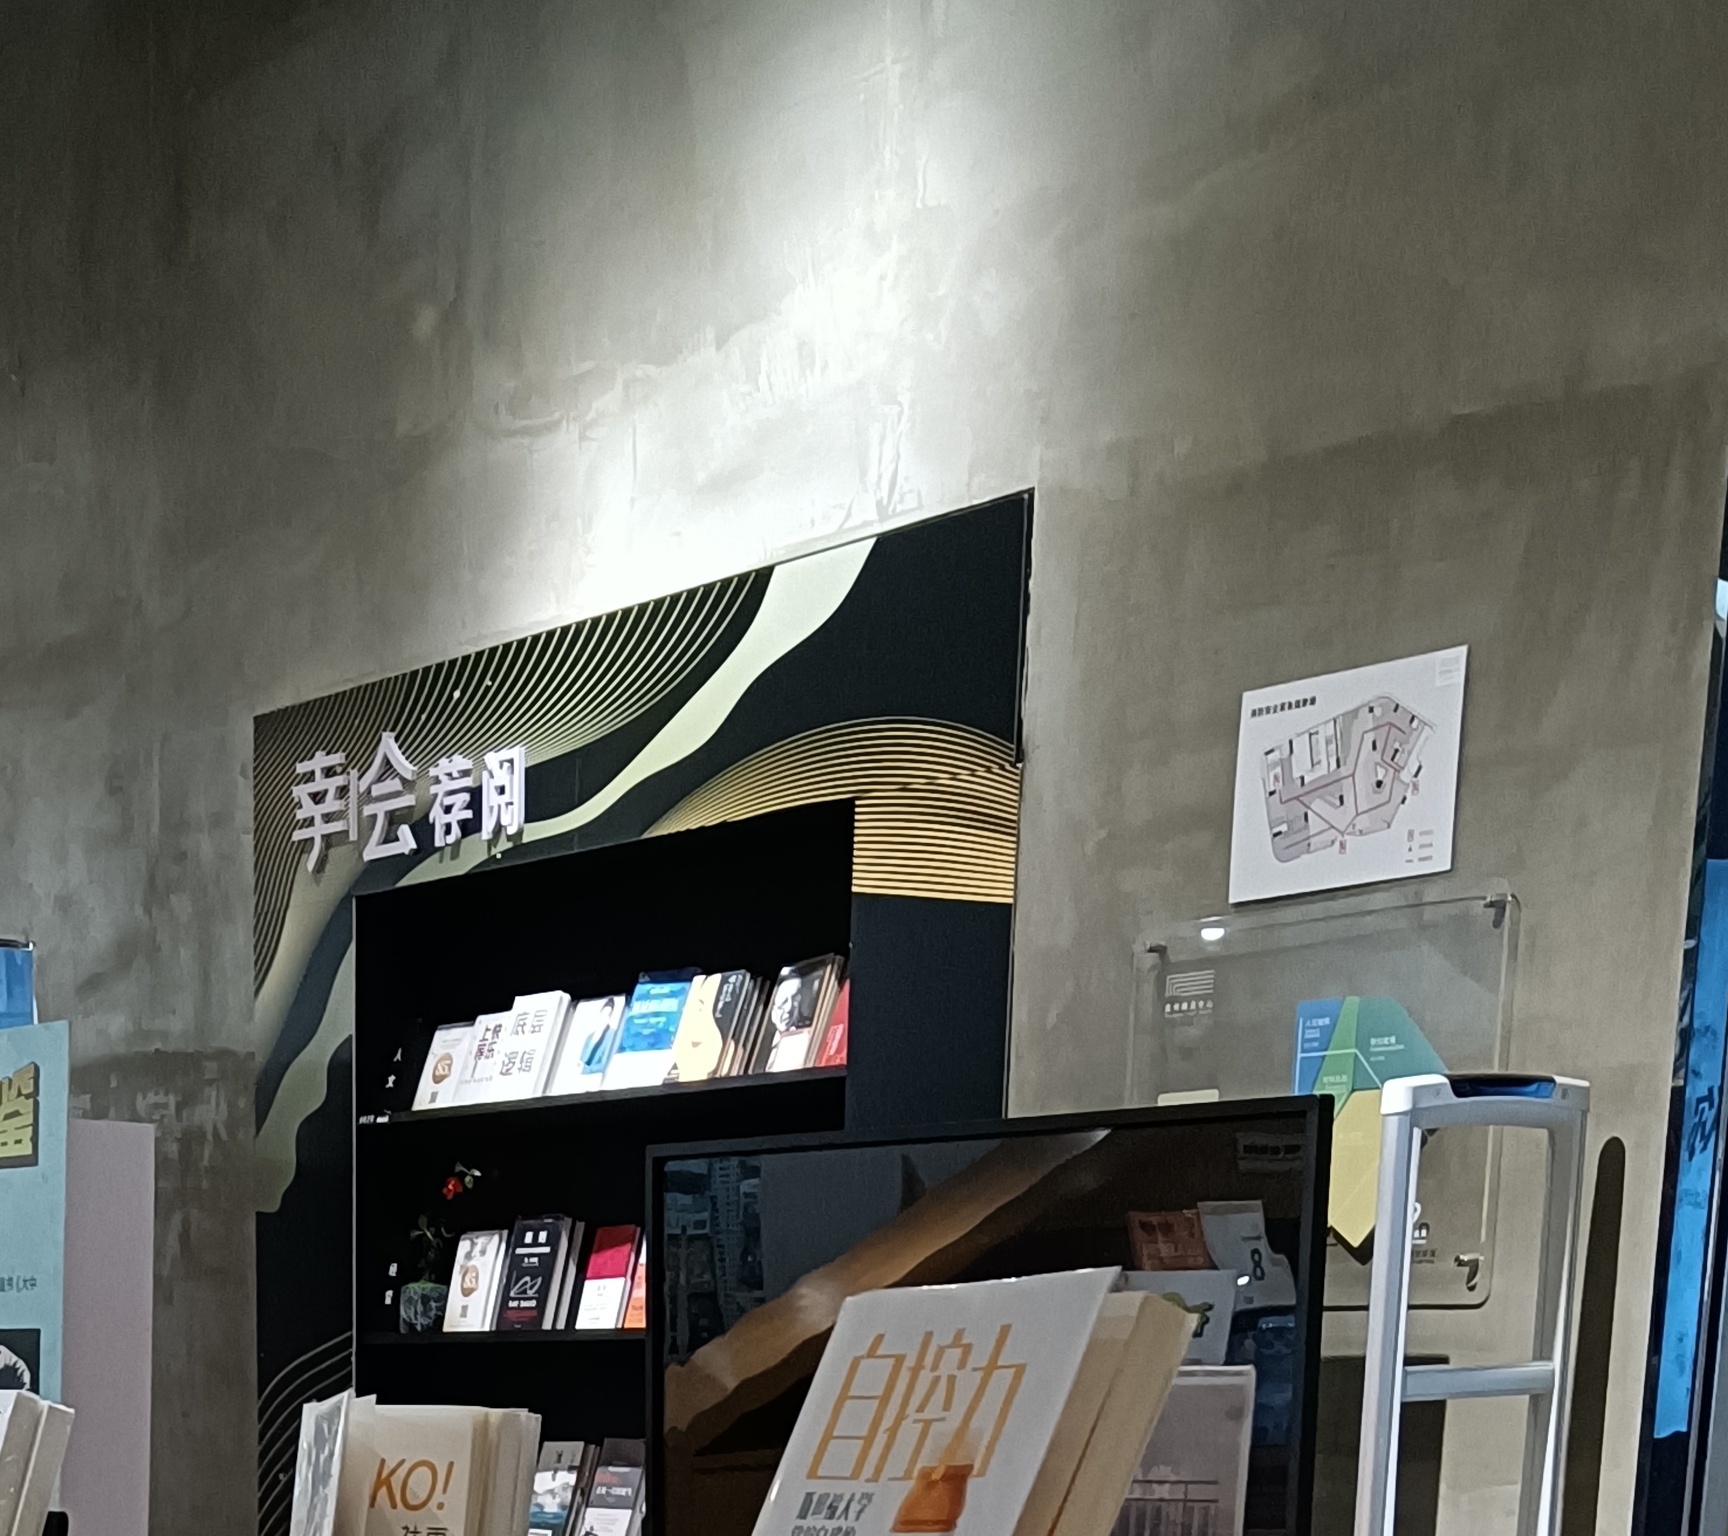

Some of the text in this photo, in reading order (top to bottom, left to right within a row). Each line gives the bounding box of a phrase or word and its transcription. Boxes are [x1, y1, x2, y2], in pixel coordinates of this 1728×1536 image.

[806, 1324, 1026, 1483] 自控力
[370, 1458, 455, 1512] KO!
